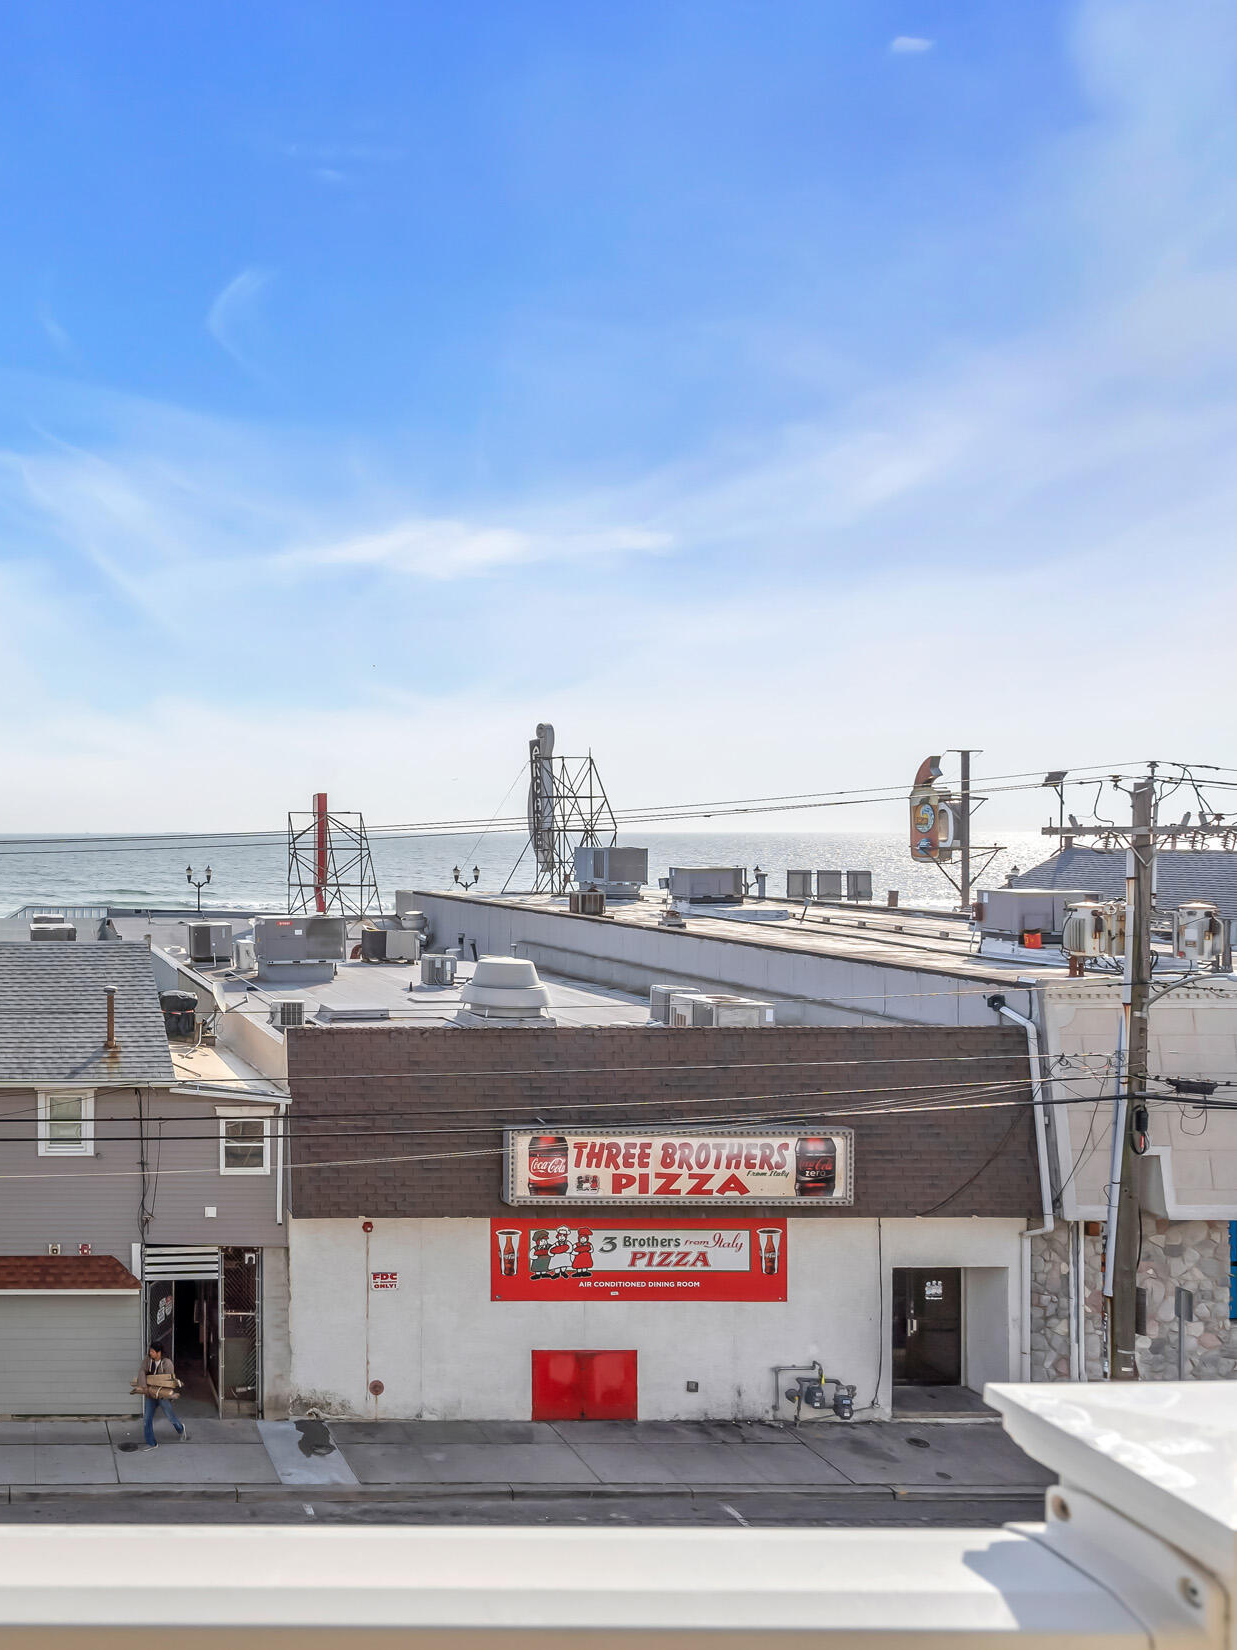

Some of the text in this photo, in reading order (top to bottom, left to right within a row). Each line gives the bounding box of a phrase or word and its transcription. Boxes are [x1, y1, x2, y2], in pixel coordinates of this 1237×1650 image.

[531, 1157, 566, 1173] Coca-Cola
[573, 1141, 790, 1172] THREE BROTHERS
[768, 1170, 790, 1178] Italy
[612, 1172, 751, 1196] PIZZA
[598, 1236, 618, 1253] 3
[623, 1236, 681, 1249] Brothers
[707, 1232, 744, 1253] Italy
[627, 1251, 711, 1267] PIZZA
